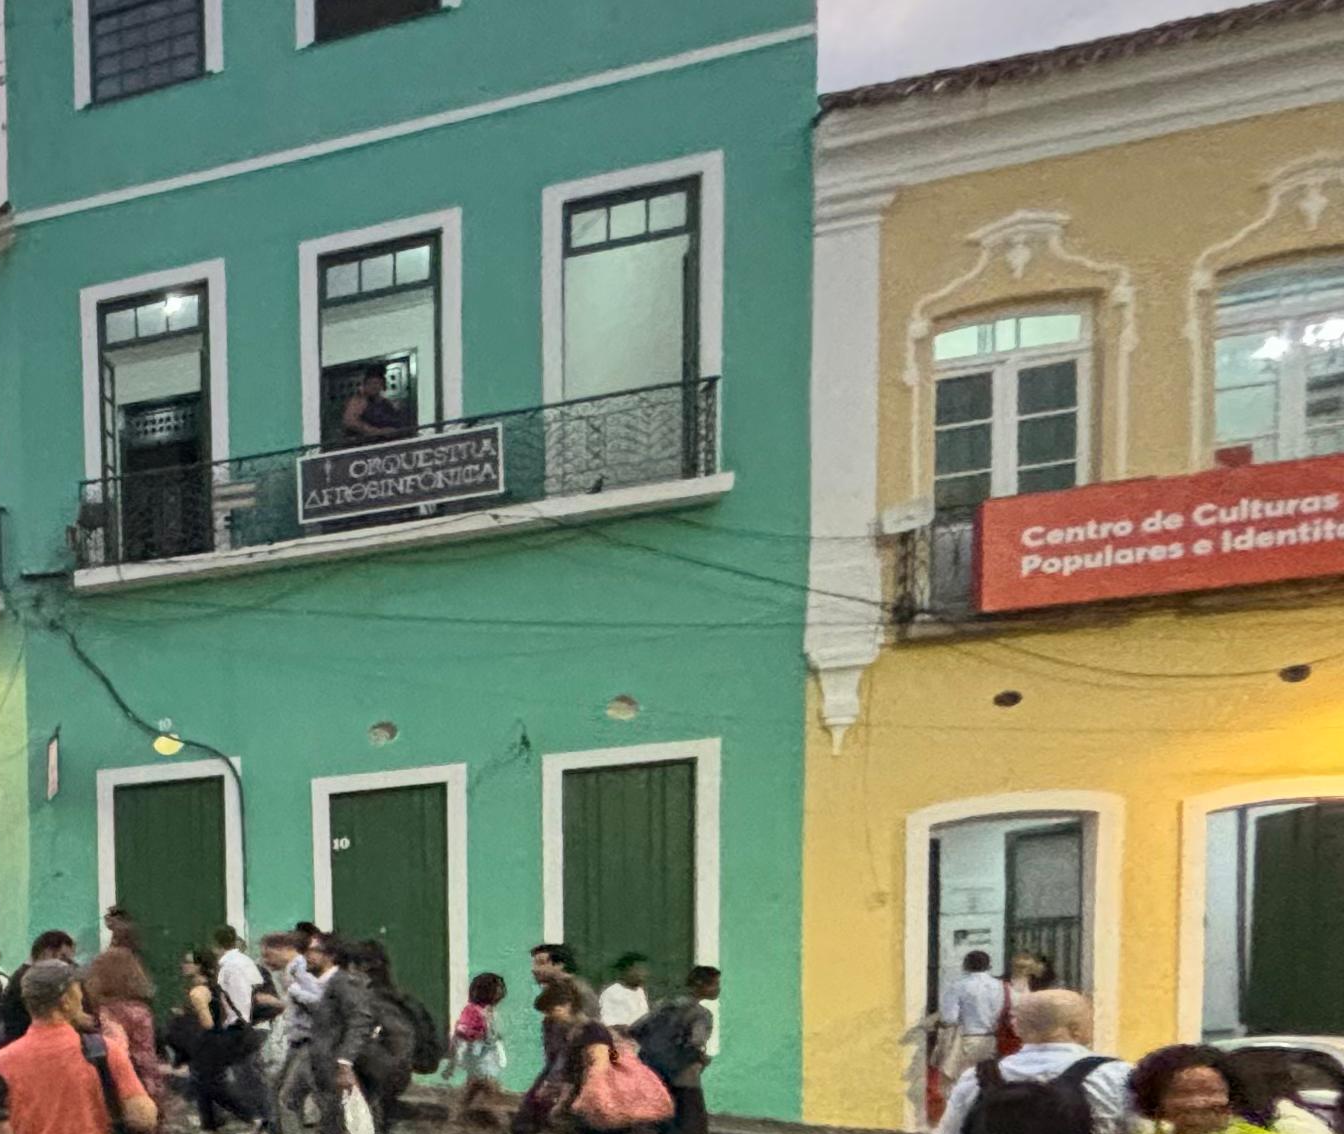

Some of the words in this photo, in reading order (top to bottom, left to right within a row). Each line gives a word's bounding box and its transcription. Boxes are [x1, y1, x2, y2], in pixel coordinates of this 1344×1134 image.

[349, 438, 497, 479] ORQUESTRA
[1021, 519, 1133, 548] Centro
[1141, 509, 1185, 533] de
[1192, 493, 1339, 526] Culturas
[1021, 542, 1185, 577] Populares
[1192, 539, 1213, 556] e
[332, 837, 351, 851] 10
